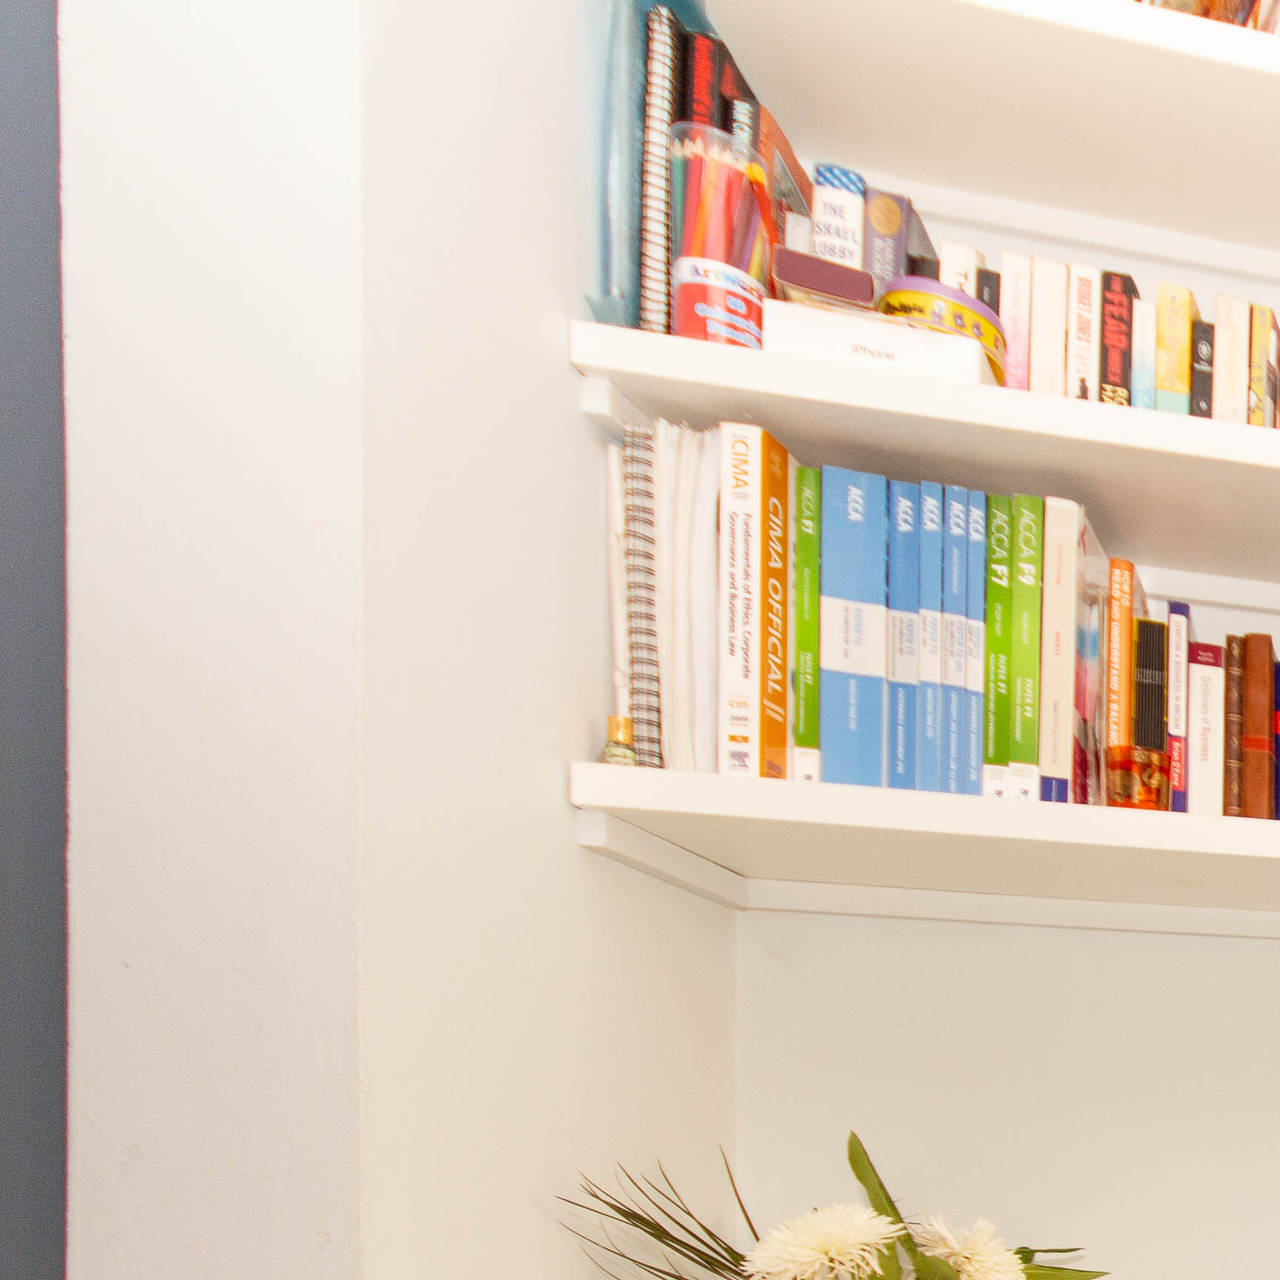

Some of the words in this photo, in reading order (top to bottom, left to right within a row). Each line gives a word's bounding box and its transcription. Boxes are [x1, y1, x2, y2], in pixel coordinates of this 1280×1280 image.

[1104, 290, 1130, 351] FEAR
[731, 440, 750, 489] CIMA
[802, 485, 814, 517] ACCA
[848, 485, 863, 522] ACCA
[898, 496, 913, 533] ACCA
[923, 495, 939, 531] ACCA
[950, 499, 965, 537] ACCA
[728, 512, 738, 569] Governance
[768, 496, 783, 568] CIMA
[968, 506, 983, 542] ACCA
[992, 509, 1008, 559] ACCA
[1018, 507, 1034, 558] ACCA
[743, 512, 752, 581] Fundamentals
[991, 563, 1008, 588] F7
[1017, 562, 1035, 586] F9
[1112, 568, 1121, 597] READ
[1121, 570, 1130, 592] HOW
[728, 592, 738, 634] Business
[740, 631, 752, 680] Corporate
[767, 578, 782, 695] OFFICIAL
[1110, 621, 1120, 690] UNDERSTAND
[1199, 727, 1213, 762] Business
